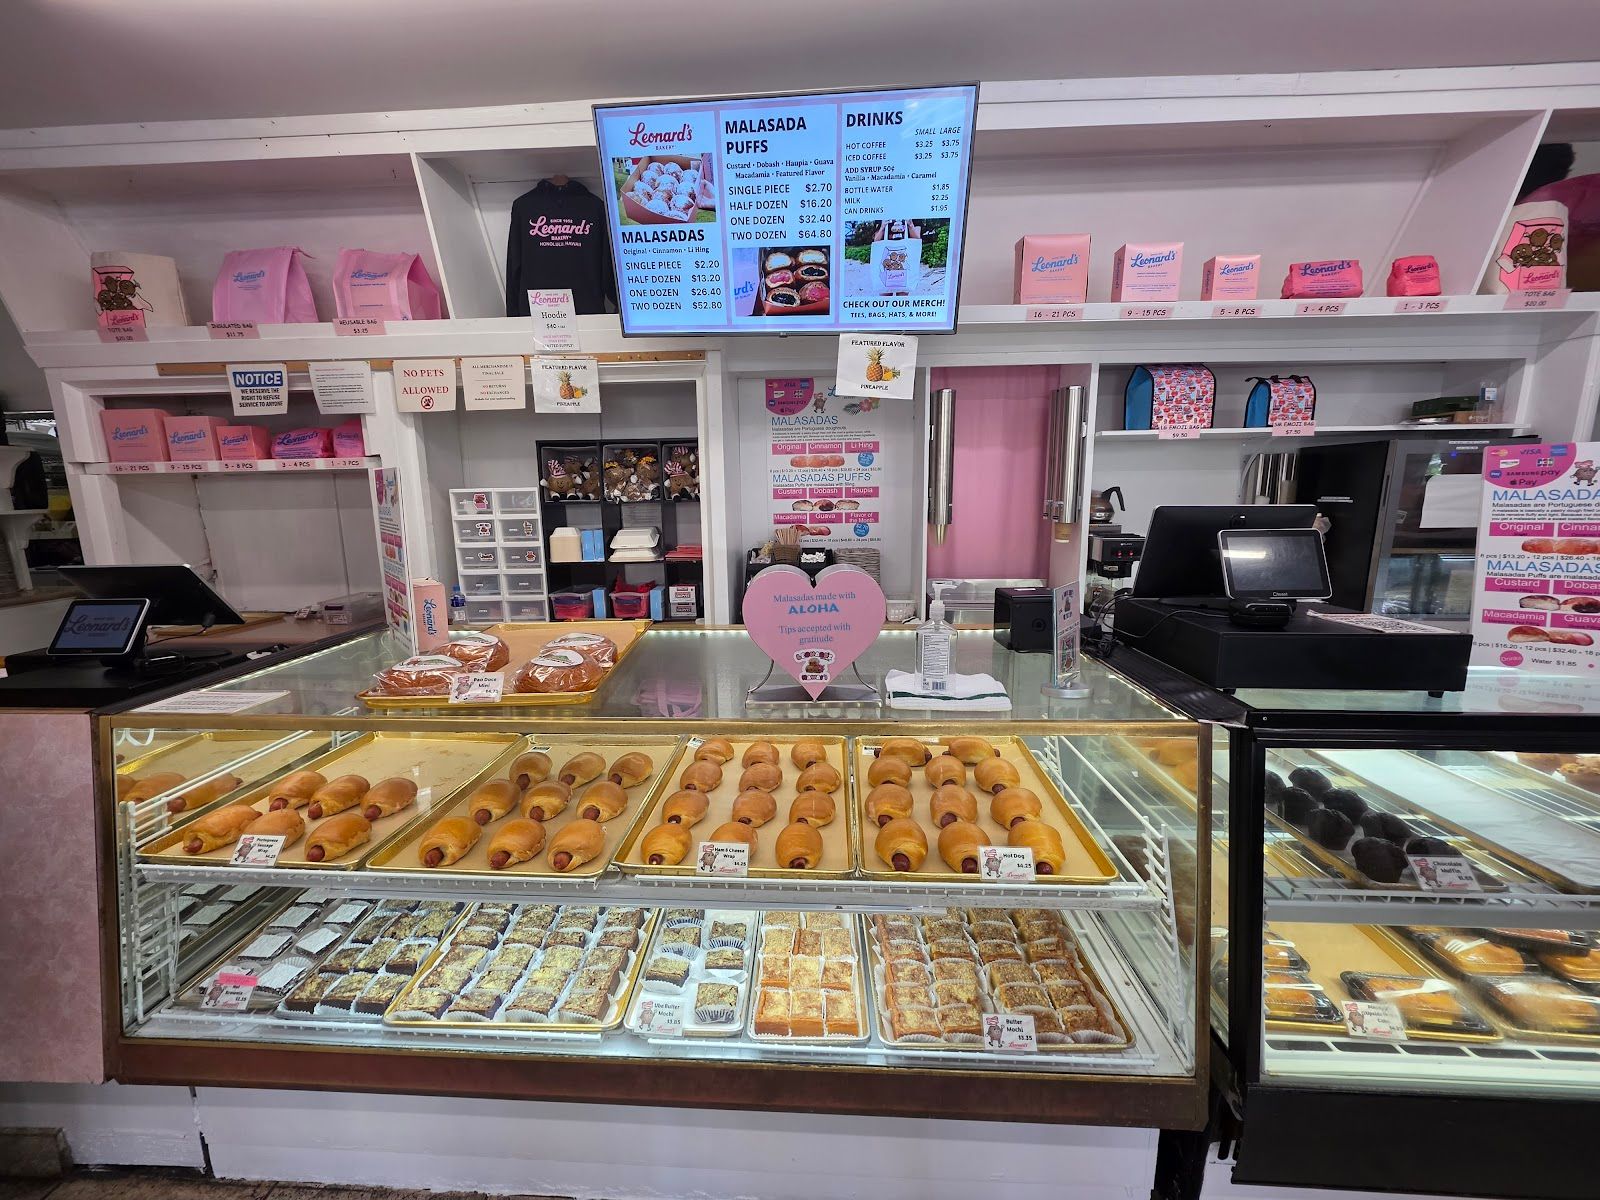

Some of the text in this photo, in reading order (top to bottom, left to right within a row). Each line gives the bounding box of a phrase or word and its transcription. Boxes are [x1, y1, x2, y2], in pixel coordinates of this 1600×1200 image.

[846, 111, 903, 127] DRINKS
[726, 117, 806, 134] MALASADA
[915, 126, 961, 136] SMALL LARGE
[629, 122, 693, 147] Leonard's
[726, 140, 768, 154] PUFFS
[915, 140, 933, 148] $3.25
[846, 154, 860, 162] ICED
[914, 152, 932, 160] $3.25
[726, 158, 834, 170] Custard Dobash Haupia Guava
[736, 171, 770, 179] Macadamia
[728, 183, 832, 195] SINGLE PIECE $2.70
[730, 199, 832, 210] HALF DOZEN $16.20
[730, 214, 832, 225] ONE DOZEN $32.40
[529, 216, 590, 238] Leonard's
[622, 229, 705, 243] MALASADAS
[731, 230, 832, 240] TWO DOZEN $64.80
[1032, 254, 1078, 272] Leonard's
[1130, 250, 1176, 268] Leonard's
[626, 260, 720, 270] SINGLE PIECE $2.20
[1220, 262, 1254, 276] Leonard's
[1300, 260, 1352, 276] Leonard's
[628, 274, 720, 284] HALF DOZEN $13.20
[630, 289, 647, 297] ONE
[691, 288, 721, 296] $26.40
[531, 292, 570, 305] Leonard's
[842, 299, 945, 309] CHECK OUT OUR MERCH!
[652, 302, 681, 310] DOZEN
[421, 369, 444, 377] PETS
[236, 373, 282, 385] NOTICE
[402, 386, 449, 395] ALLOWED
[771, 416, 839, 426] MALASADAS
[111, 426, 149, 441] Leonard's
[170, 428, 206, 445] Leonard's
[221, 432, 249, 446] Leonard's
[277, 431, 320, 447] Leonard's
[772, 473, 871, 483] MALASADAS PUFFS
[1499, 523, 1544, 532] Original
[1495, 578, 1540, 587] Custard
[774, 594, 814, 602] Malasadas
[788, 603, 839, 614] ALOHA
[424, 598, 437, 637] Leonard's
[1484, 611, 1545, 620] Macadamia
[64, 614, 130, 635] Leonard's
[779, 623, 850, 634] Tips accepted with
[799, 635, 833, 645] gratitude
